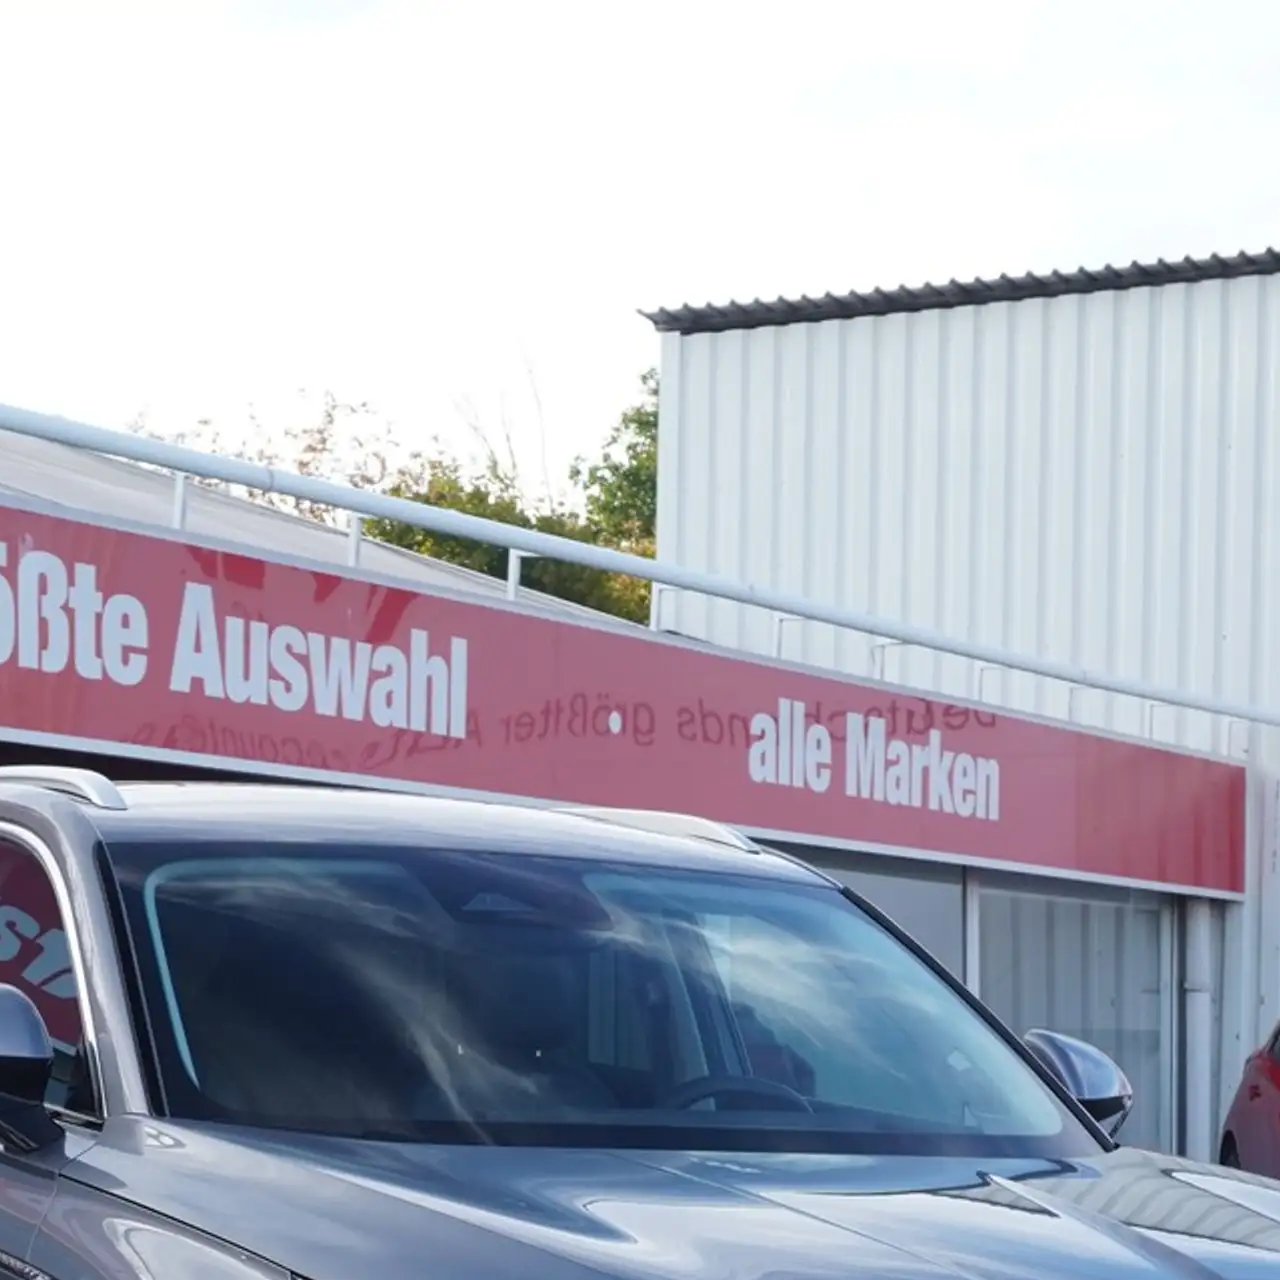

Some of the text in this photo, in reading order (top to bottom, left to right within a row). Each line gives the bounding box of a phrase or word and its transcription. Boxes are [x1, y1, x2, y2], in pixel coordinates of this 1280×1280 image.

[169, 582, 468, 740] Auswahl
[748, 697, 832, 793] alle
[845, 711, 1001, 822] Marken
